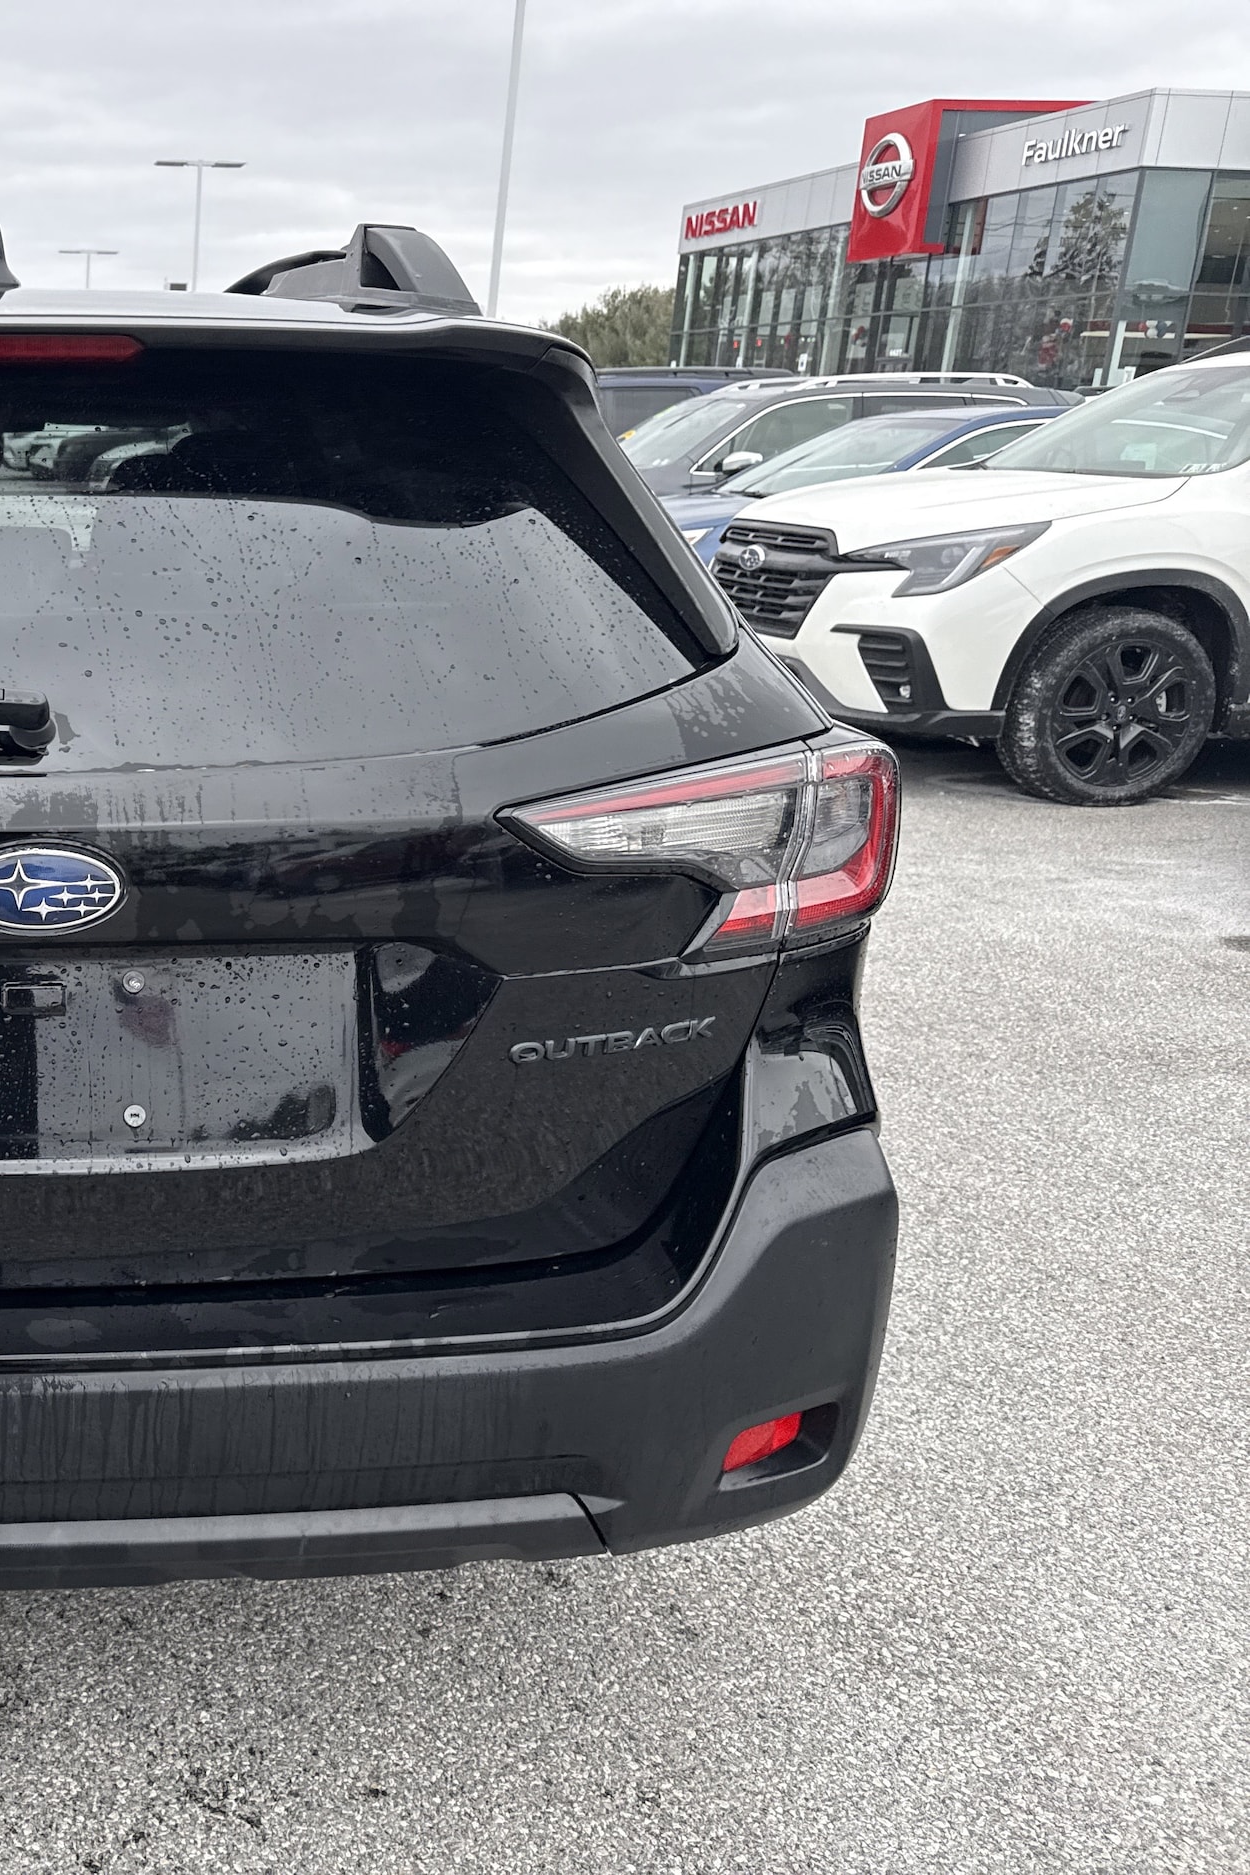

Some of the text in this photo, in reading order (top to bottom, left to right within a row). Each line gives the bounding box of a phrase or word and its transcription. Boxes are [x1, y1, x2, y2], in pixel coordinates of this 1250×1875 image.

[1021, 123, 1126, 166] Faulkner
[684, 200, 757, 240] NISSAN
[509, 1016, 716, 1064] OUTBACK
